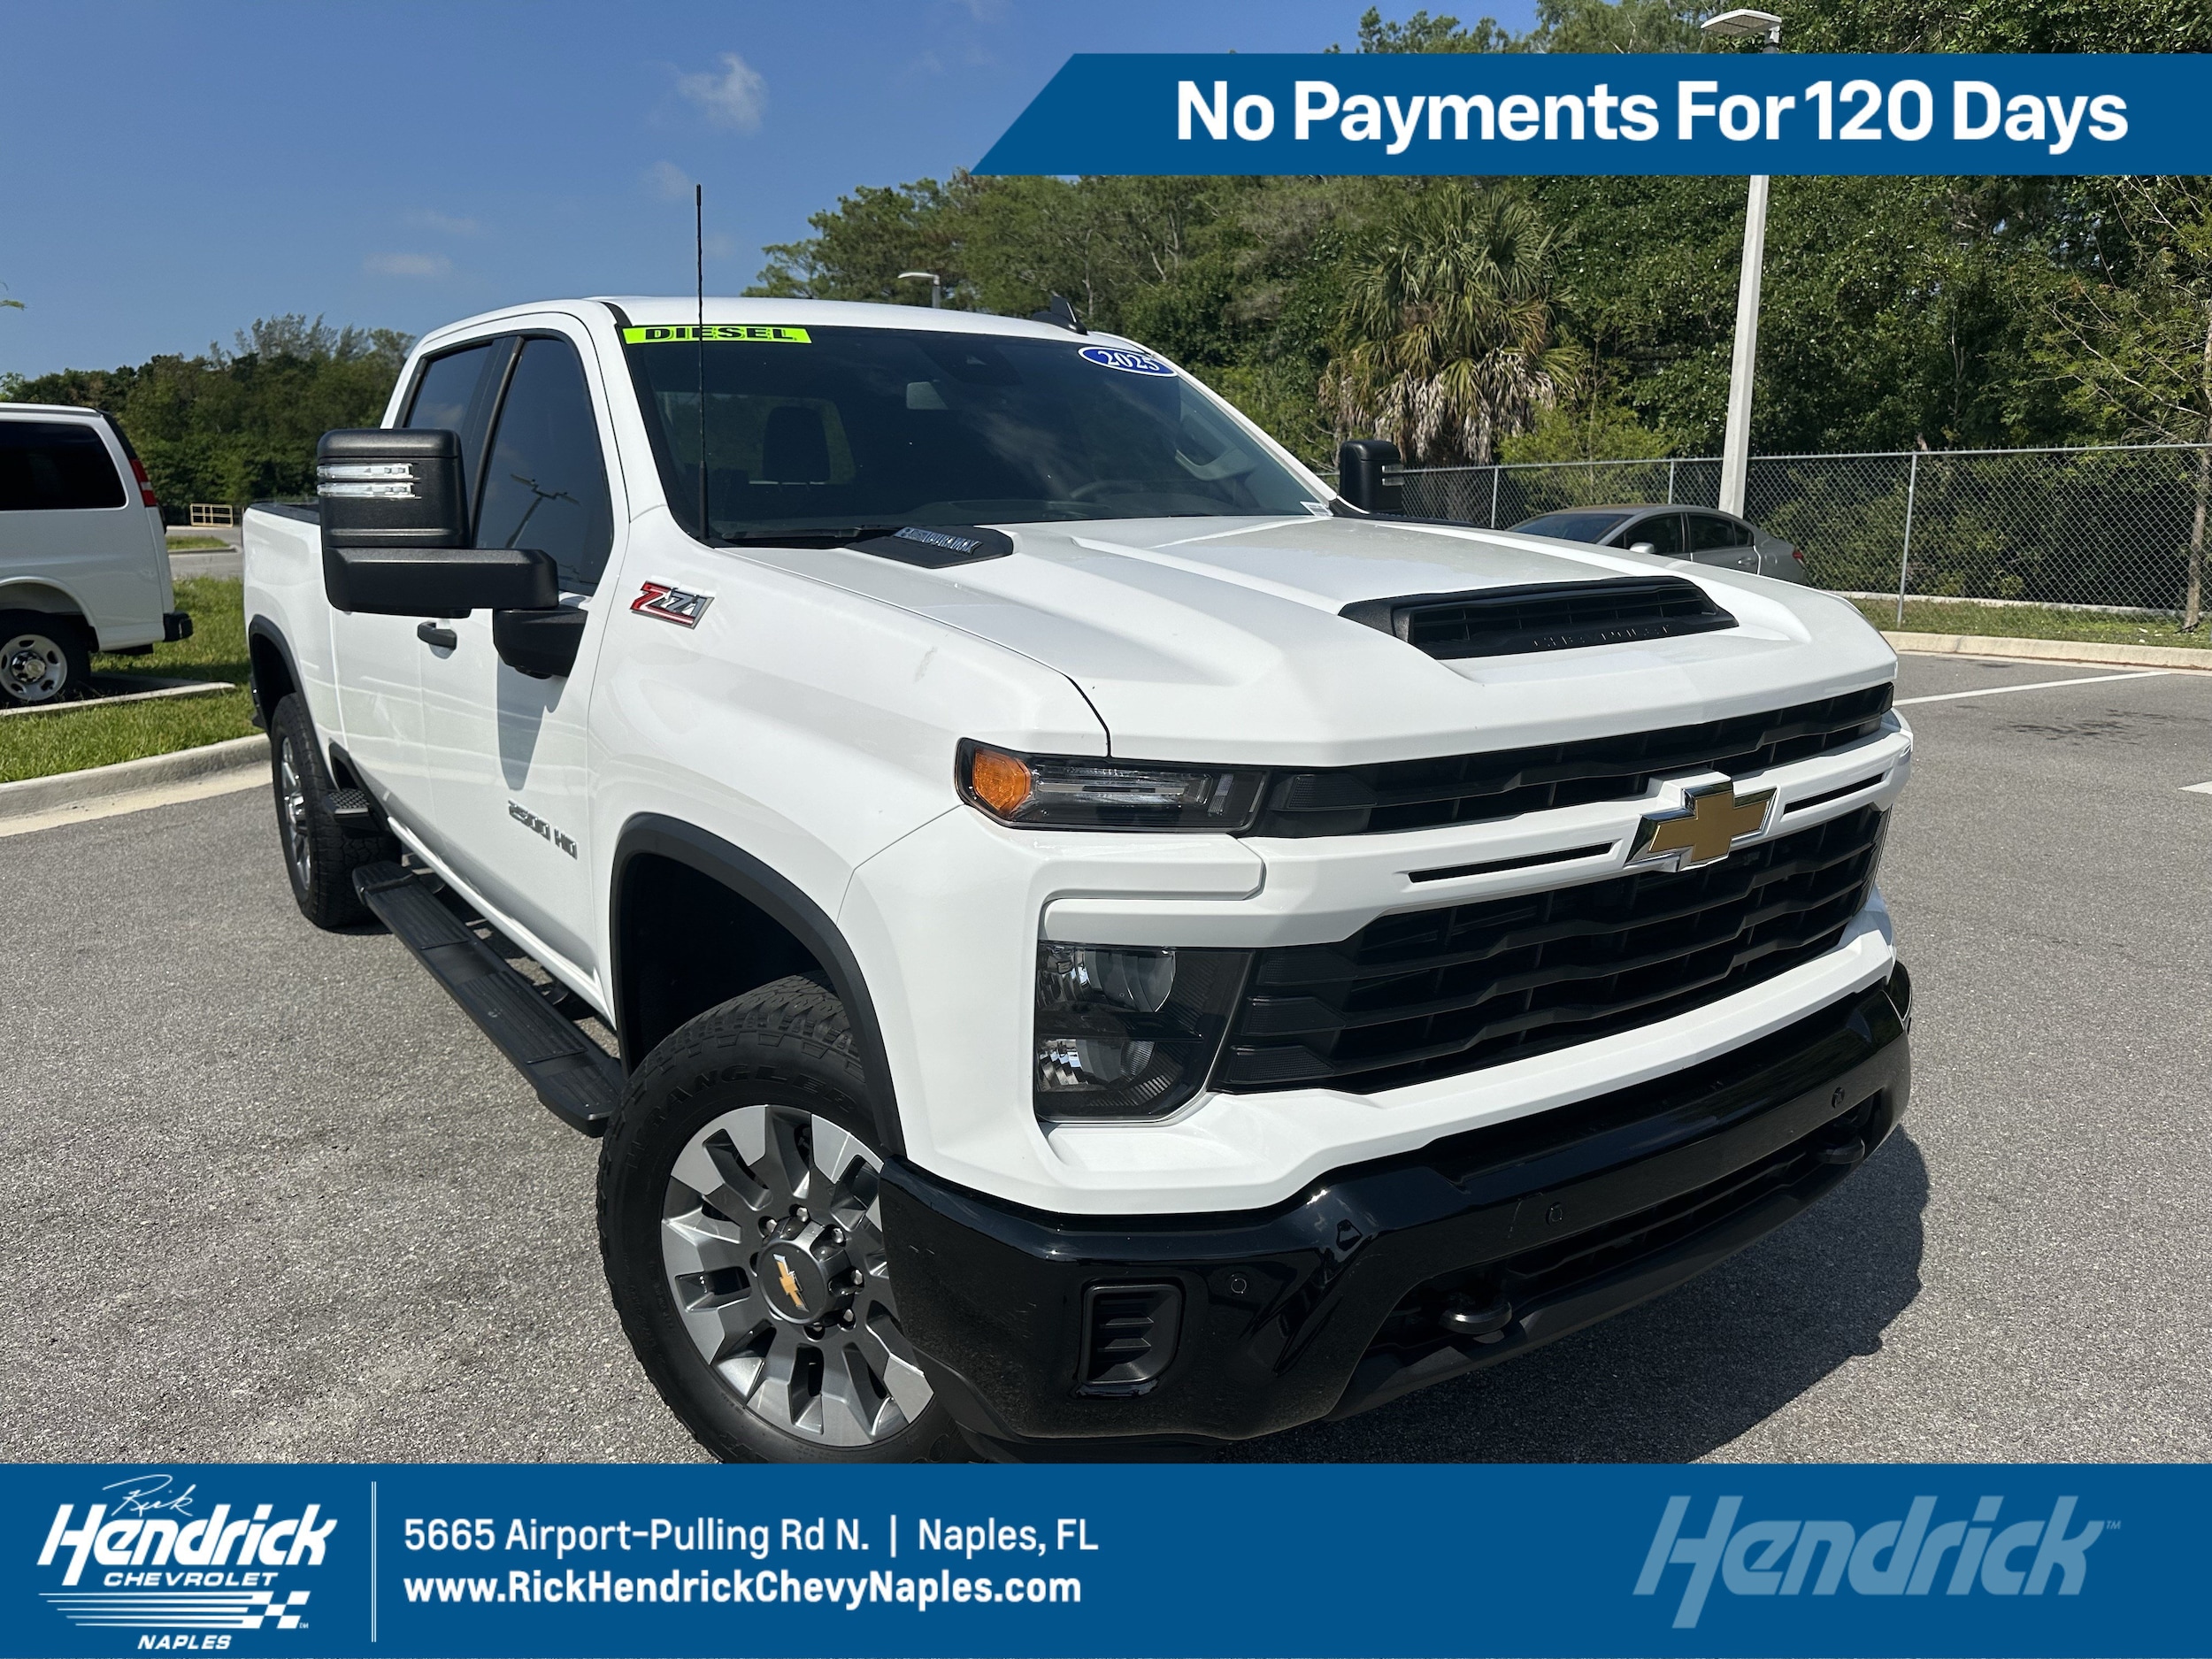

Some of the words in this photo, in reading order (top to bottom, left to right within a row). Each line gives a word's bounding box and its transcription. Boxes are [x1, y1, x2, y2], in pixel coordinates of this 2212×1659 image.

[645, 327, 797, 342] DIESEL
[1097, 350, 1160, 371] 2025
[629, 580, 715, 630] Z71
